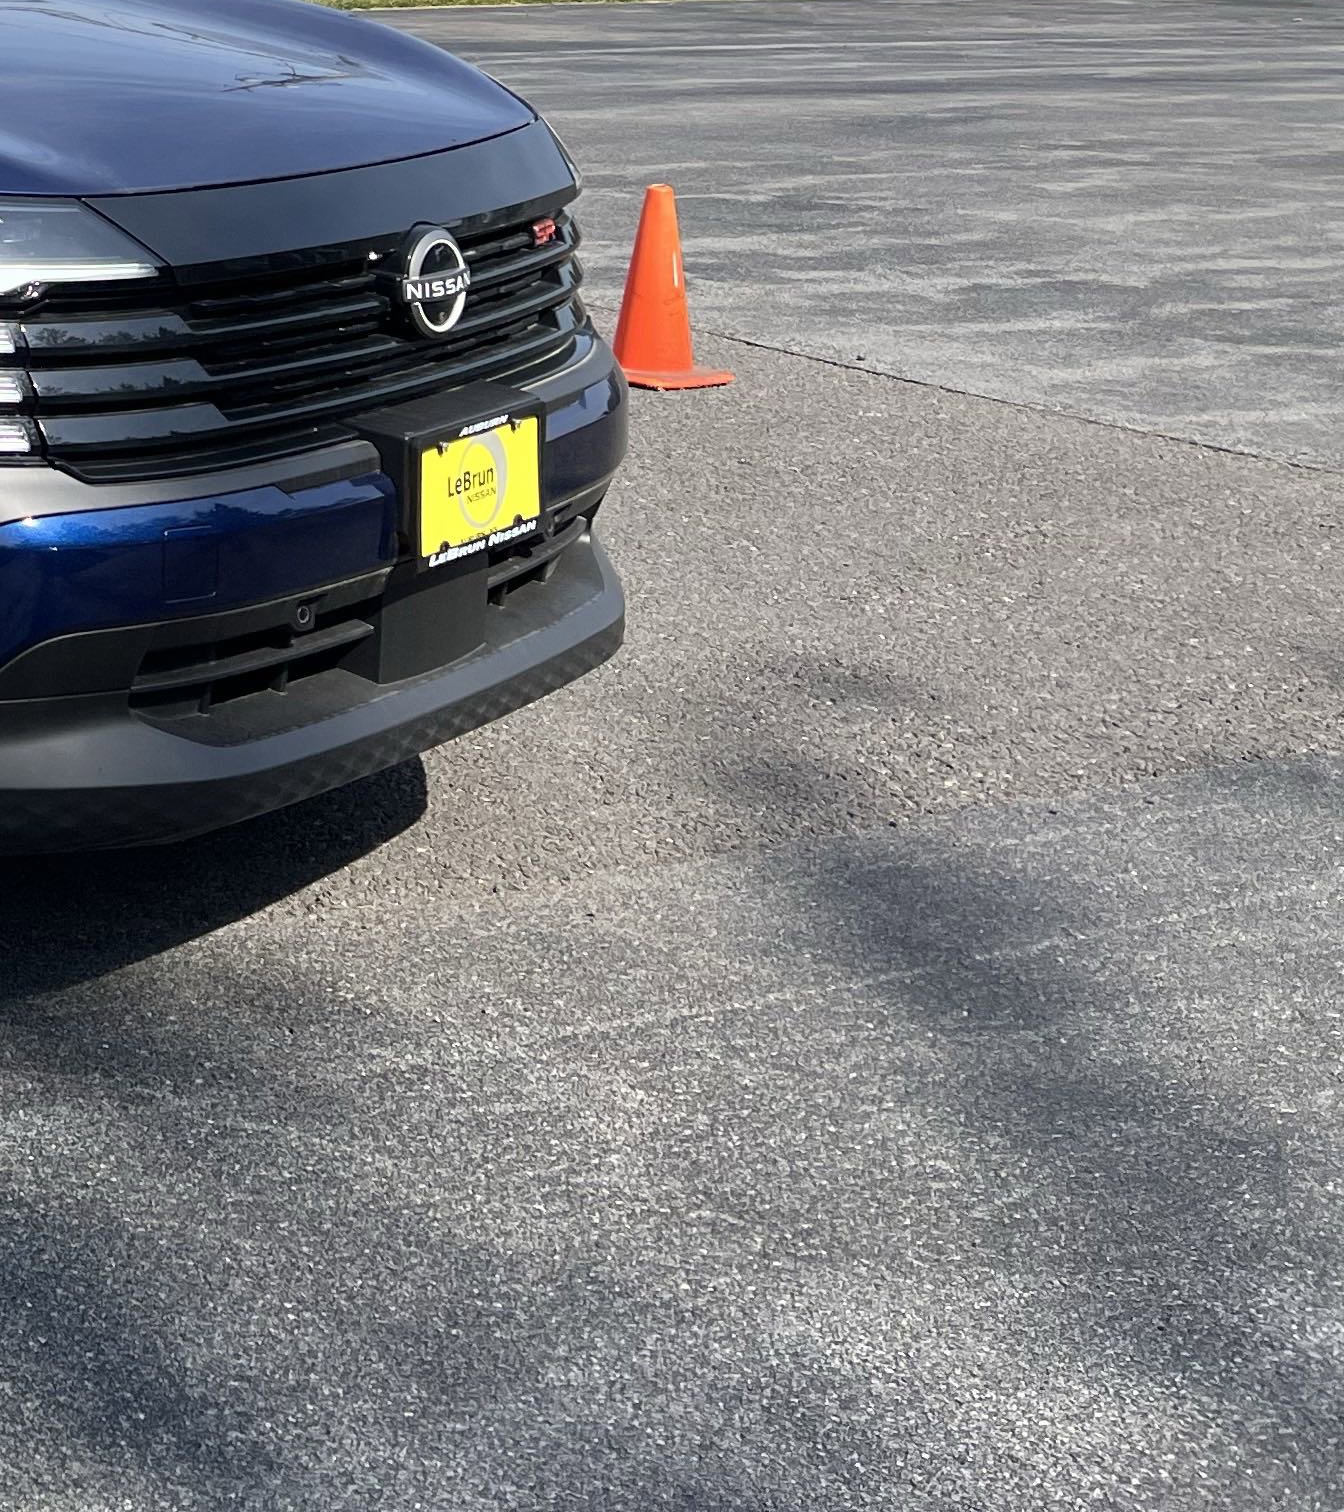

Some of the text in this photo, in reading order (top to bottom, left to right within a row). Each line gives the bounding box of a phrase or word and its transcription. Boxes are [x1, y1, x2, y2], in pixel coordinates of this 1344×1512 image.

[406, 270, 471, 300] NISSAN
[459, 414, 509, 437] AUBURN
[448, 467, 494, 498] LeBrun
[467, 487, 497, 504] NISSAN
